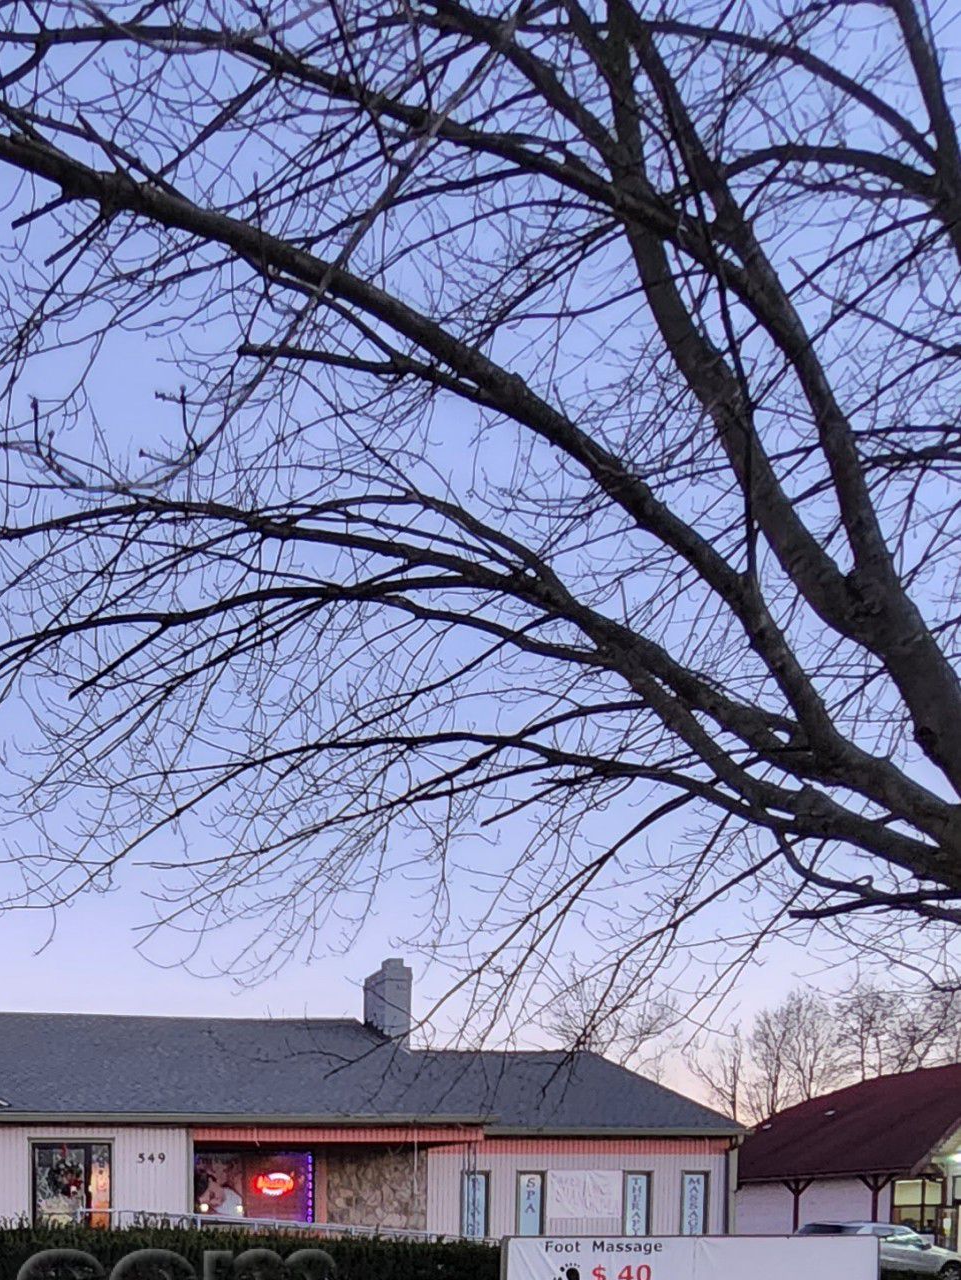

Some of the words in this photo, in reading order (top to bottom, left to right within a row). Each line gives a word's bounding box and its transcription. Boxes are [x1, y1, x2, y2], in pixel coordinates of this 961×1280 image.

[137, 1152, 166, 1164] 549
[524, 1177, 536, 1214] SPA
[631, 1177, 642, 1236] THERAPY
[545, 1240, 581, 1253] Foot
[591, 1240, 663, 1255] Massage
